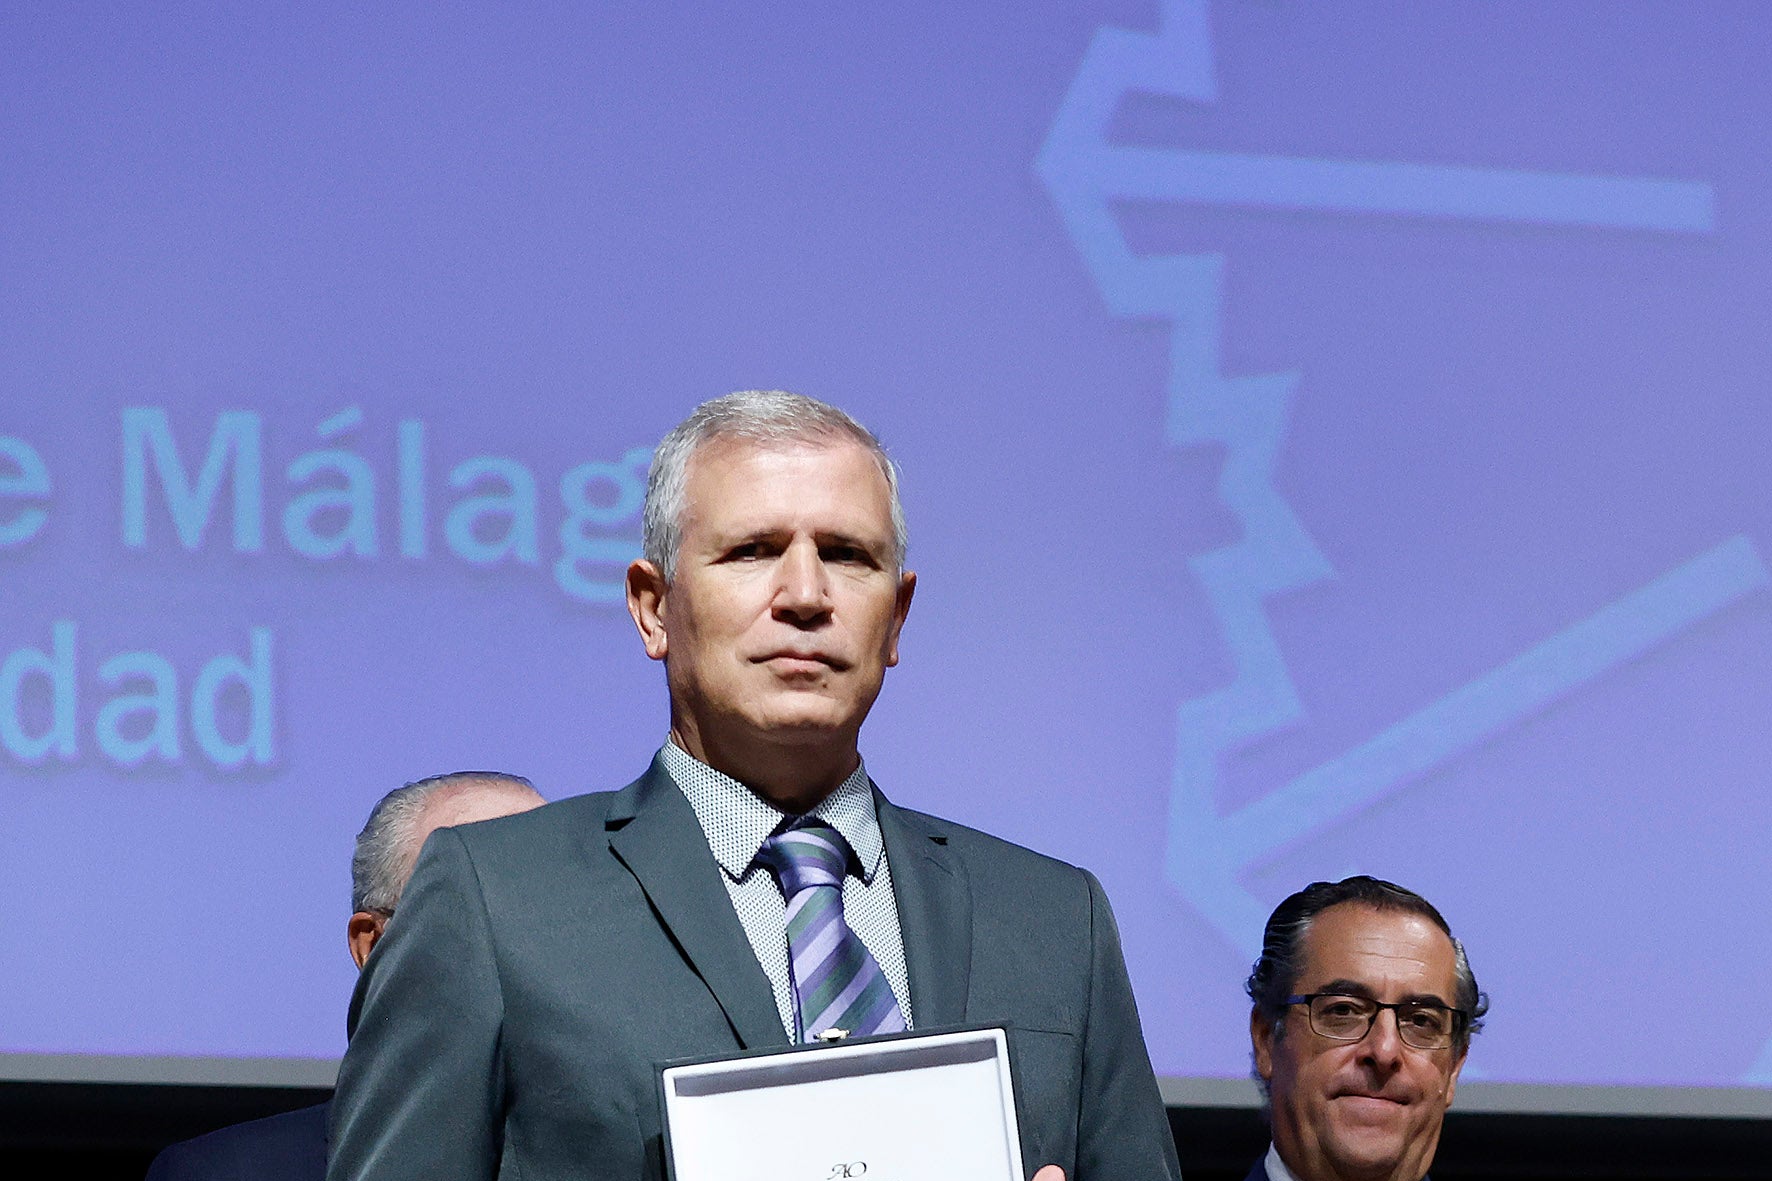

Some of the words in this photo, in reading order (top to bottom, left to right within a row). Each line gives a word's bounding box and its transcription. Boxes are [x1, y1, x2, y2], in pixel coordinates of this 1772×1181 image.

[0, 433, 53, 546] e
[120, 405, 648, 602] Málag
[0, 619, 275, 765] dad
